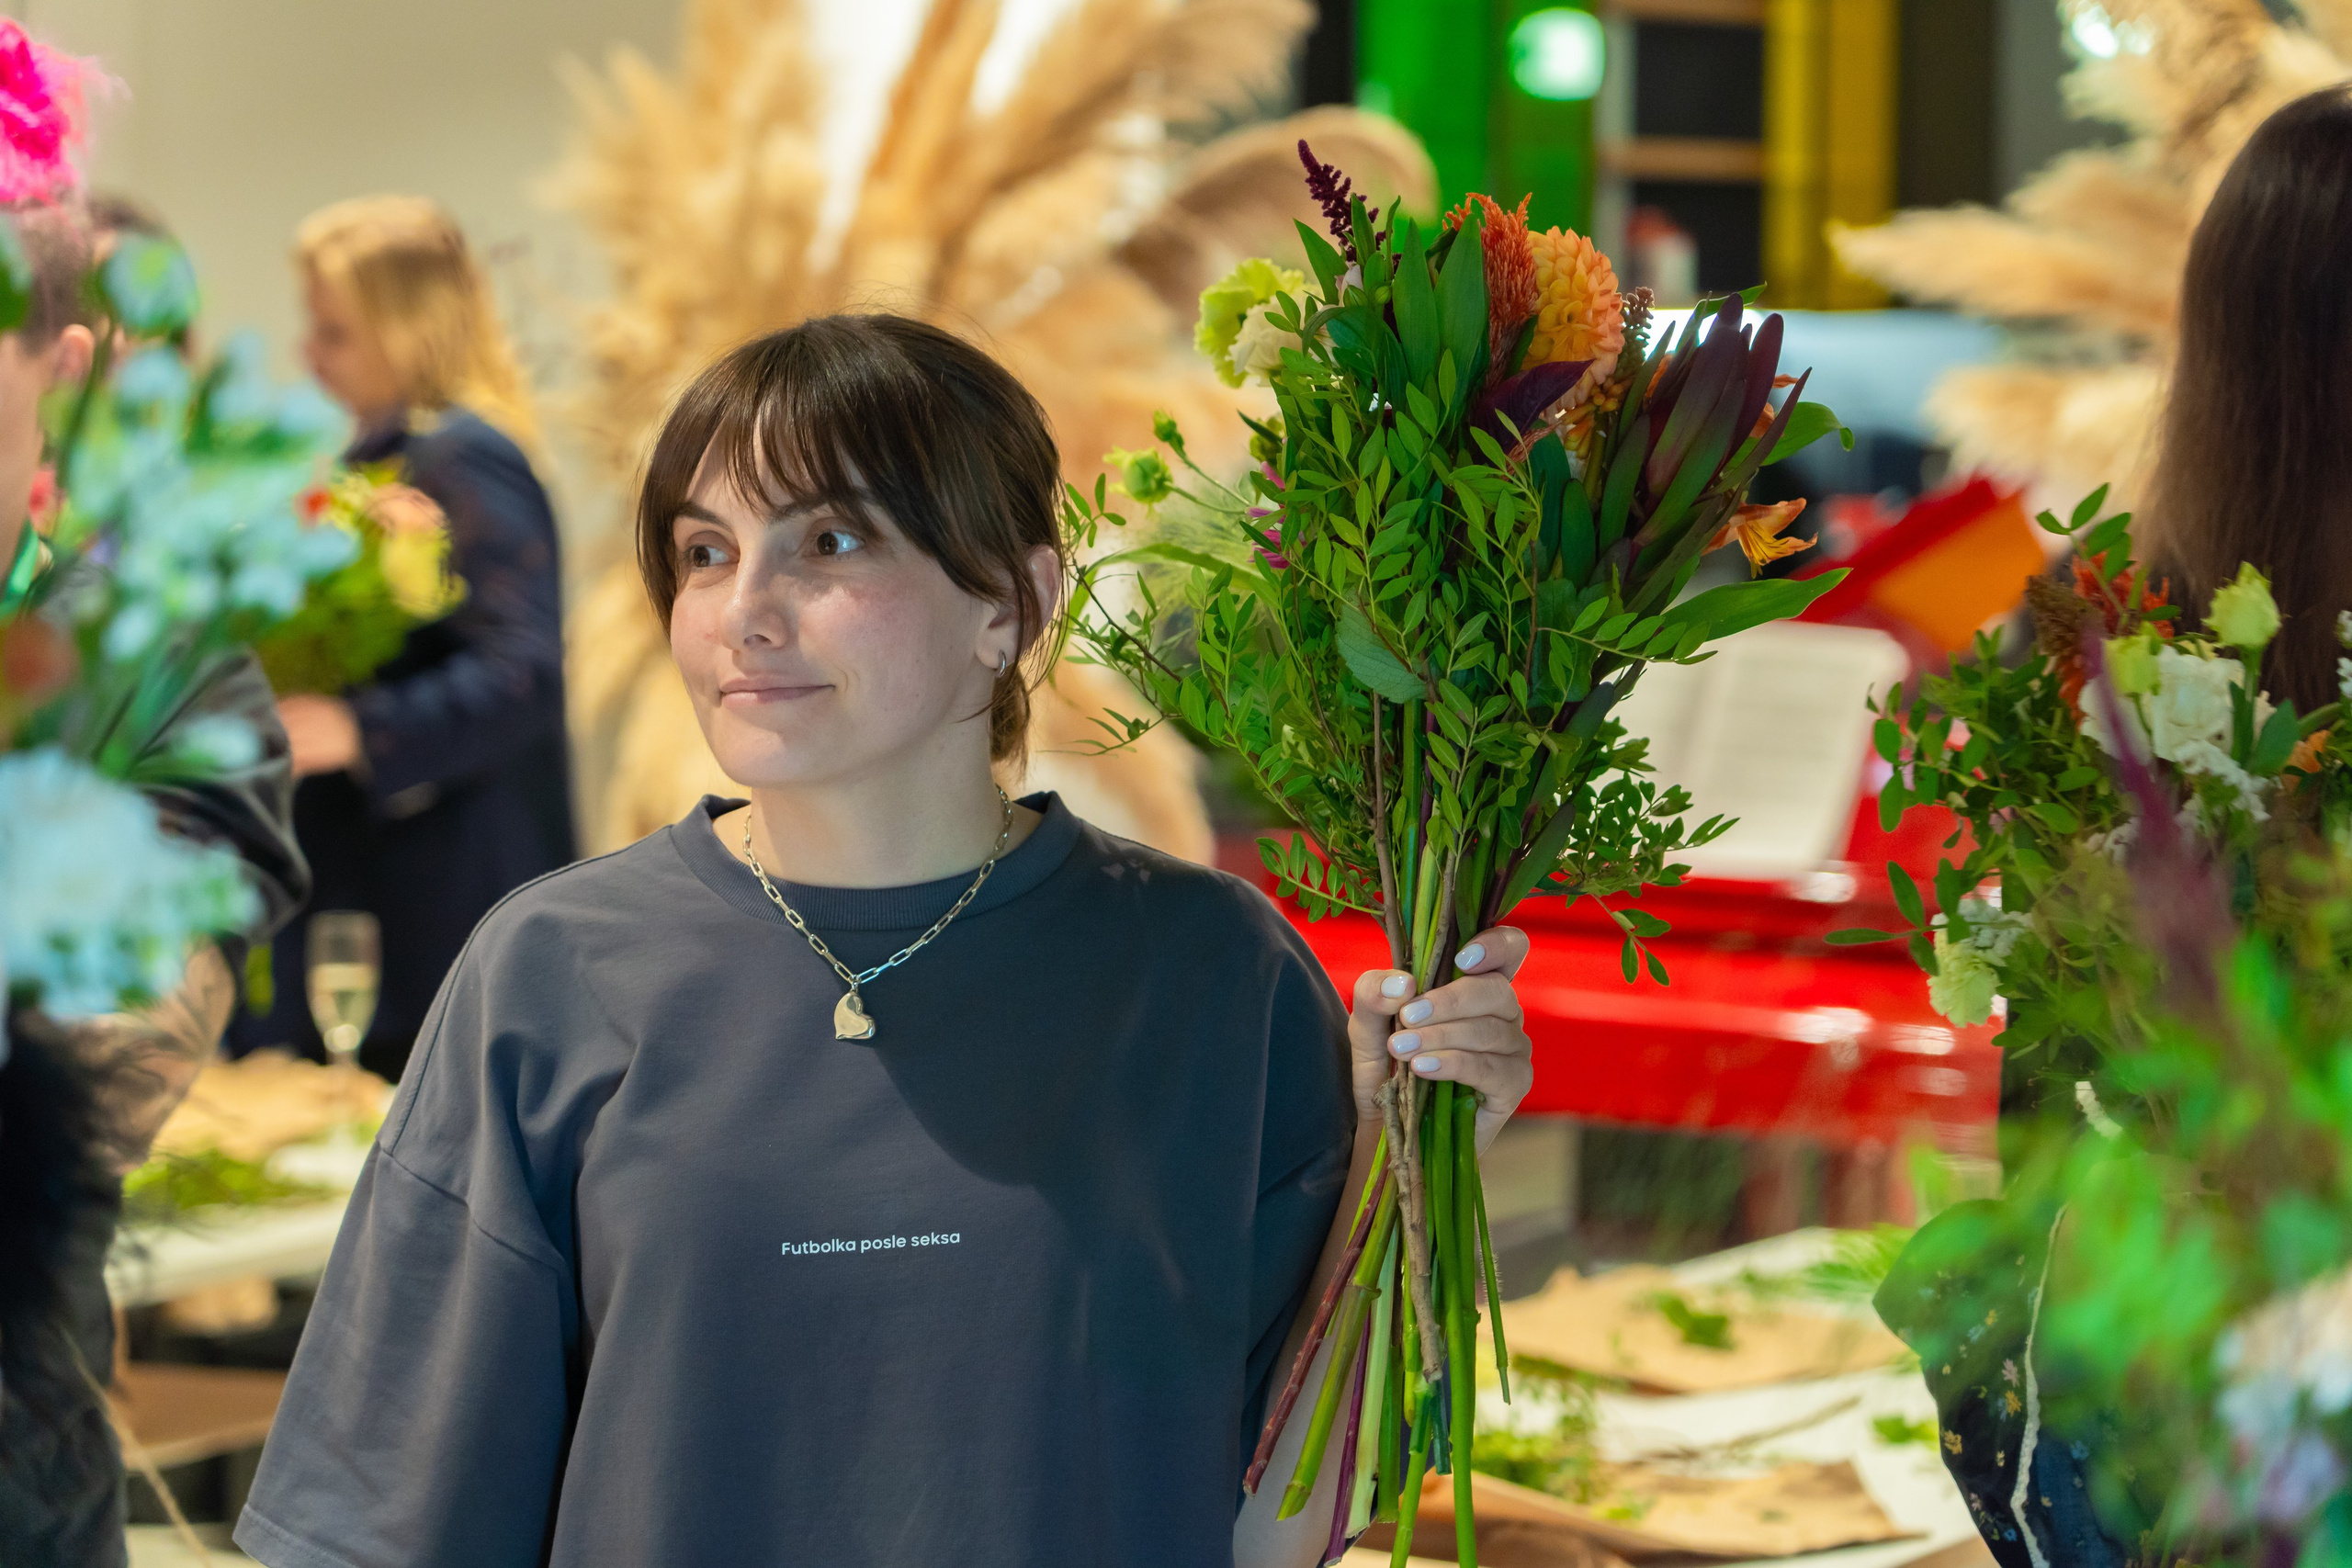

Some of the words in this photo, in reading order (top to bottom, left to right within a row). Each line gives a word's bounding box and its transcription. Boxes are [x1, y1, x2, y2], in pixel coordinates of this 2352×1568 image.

[781, 1238, 856, 1256] Futbolka
[860, 1234, 907, 1254] posle
[910, 1231, 961, 1247] seksa
